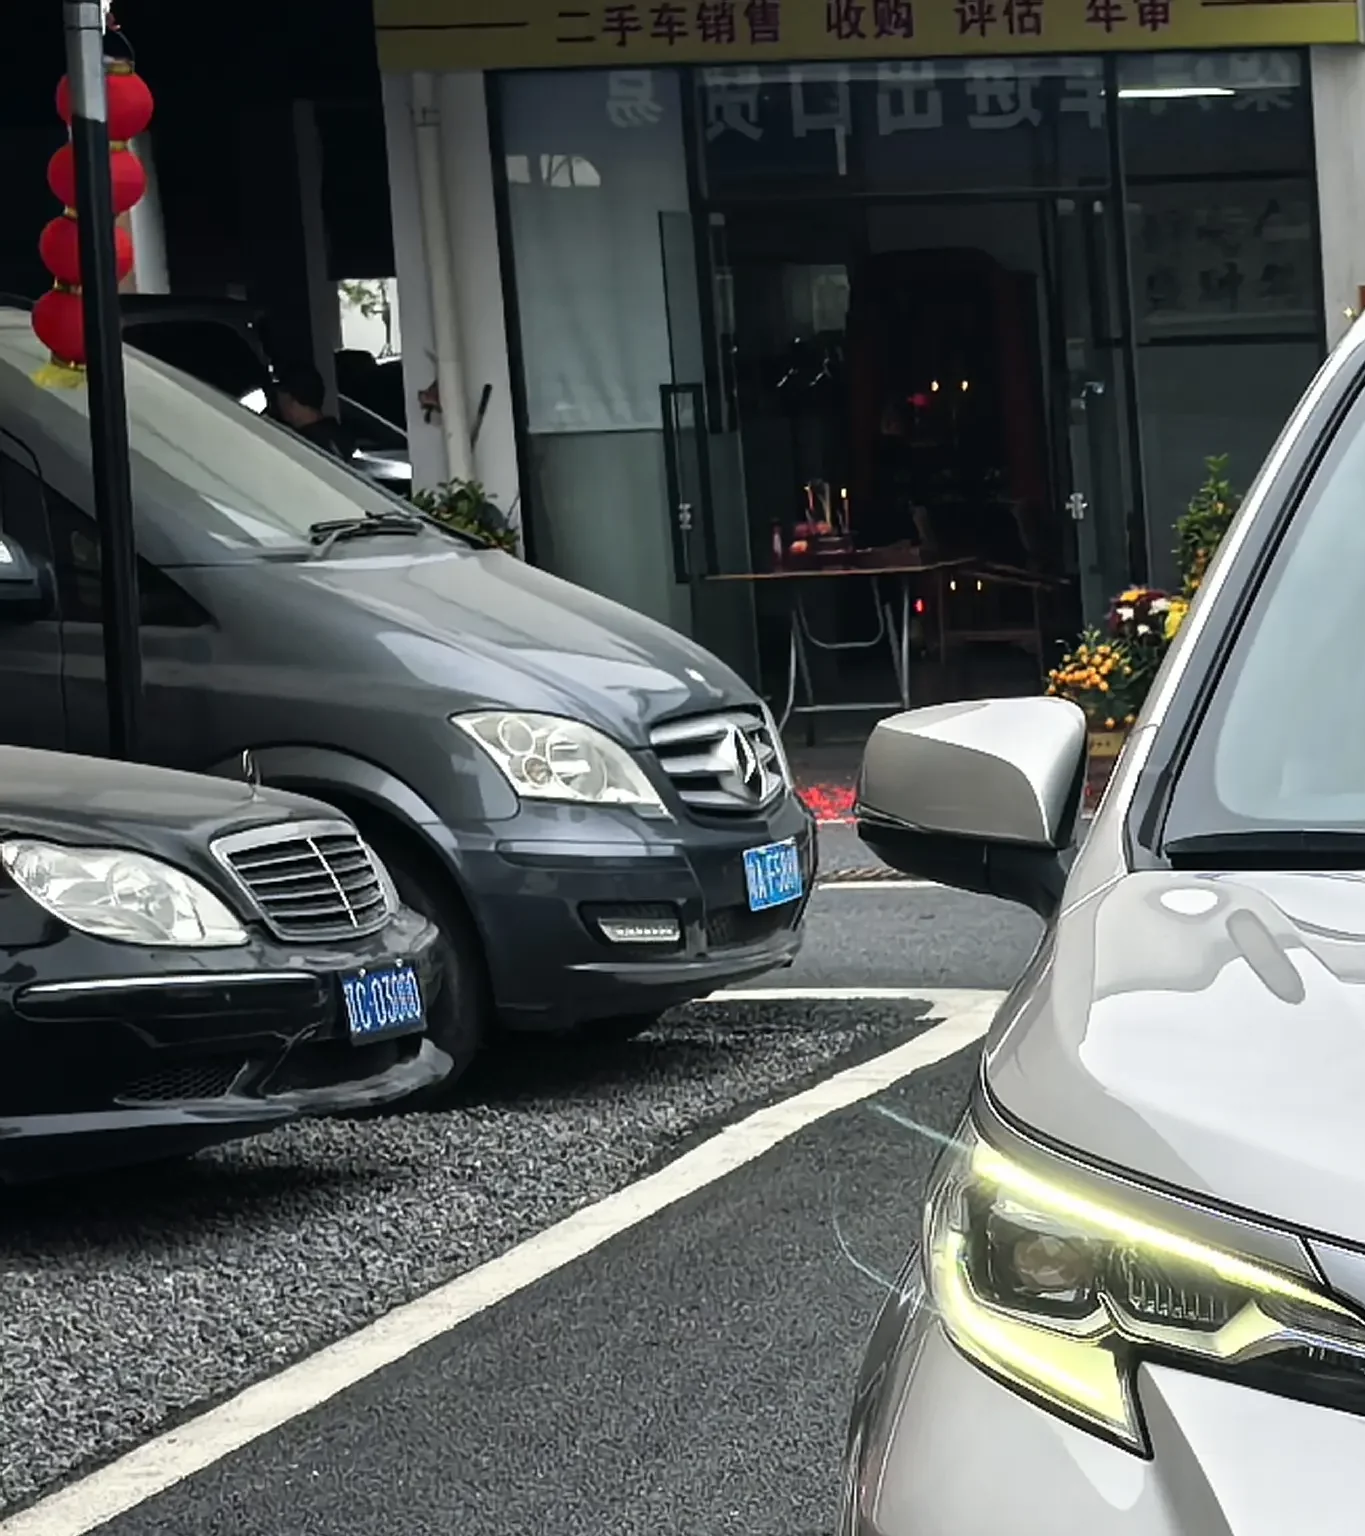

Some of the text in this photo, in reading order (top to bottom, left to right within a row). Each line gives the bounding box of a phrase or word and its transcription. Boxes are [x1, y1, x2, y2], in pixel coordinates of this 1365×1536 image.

[556, 0, 1170, 47] 二手车销售 收购 评估 年审
